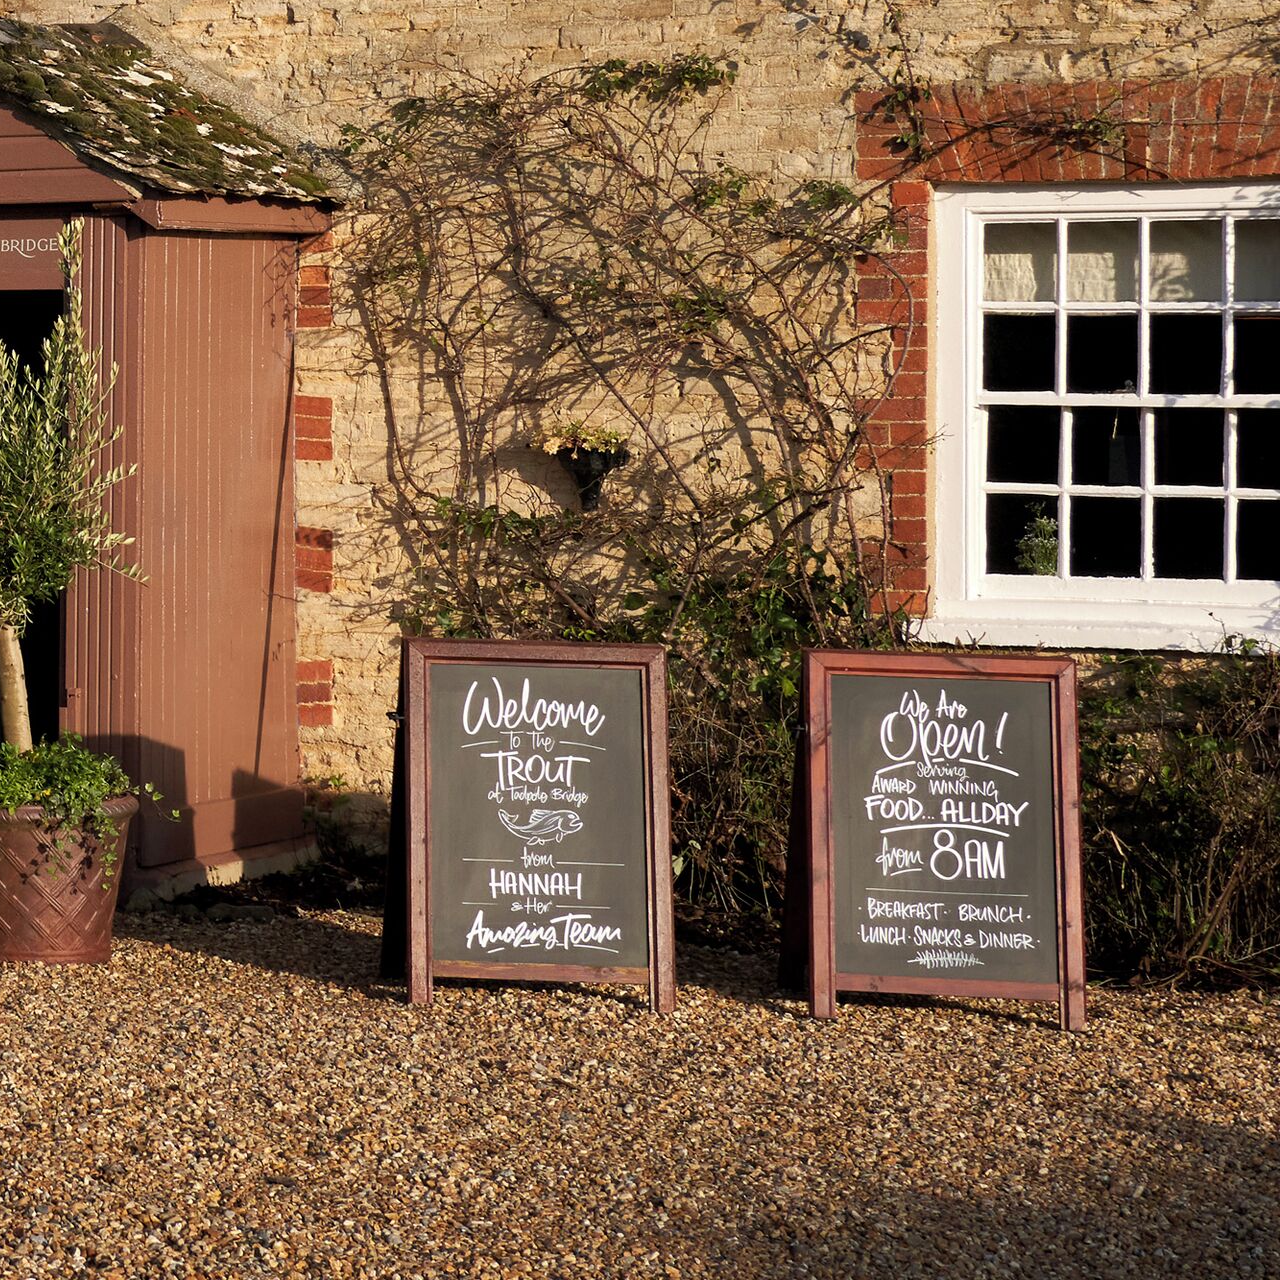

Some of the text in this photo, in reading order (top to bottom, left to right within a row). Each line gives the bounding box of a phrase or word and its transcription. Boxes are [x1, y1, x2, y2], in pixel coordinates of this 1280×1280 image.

[0, 238, 58, 258] BRIDGE
[462, 676, 606, 737] Welcome
[899, 689, 968, 723] We Are
[480, 750, 591, 791] TROUT
[487, 781, 589, 808] at Tadpole Bridge
[872, 775, 998, 802] AWARD WINNING
[520, 846, 555, 869] from
[875, 836, 924, 876] from
[489, 868, 582, 900] HANNAH
[523, 897, 553, 914] Her
[867, 897, 1024, 923] BREAKFAST BRUNCH
[466, 910, 621, 950] Amazing Team
[860, 924, 1035, 950] LUNCH SNACKS & DINNER
